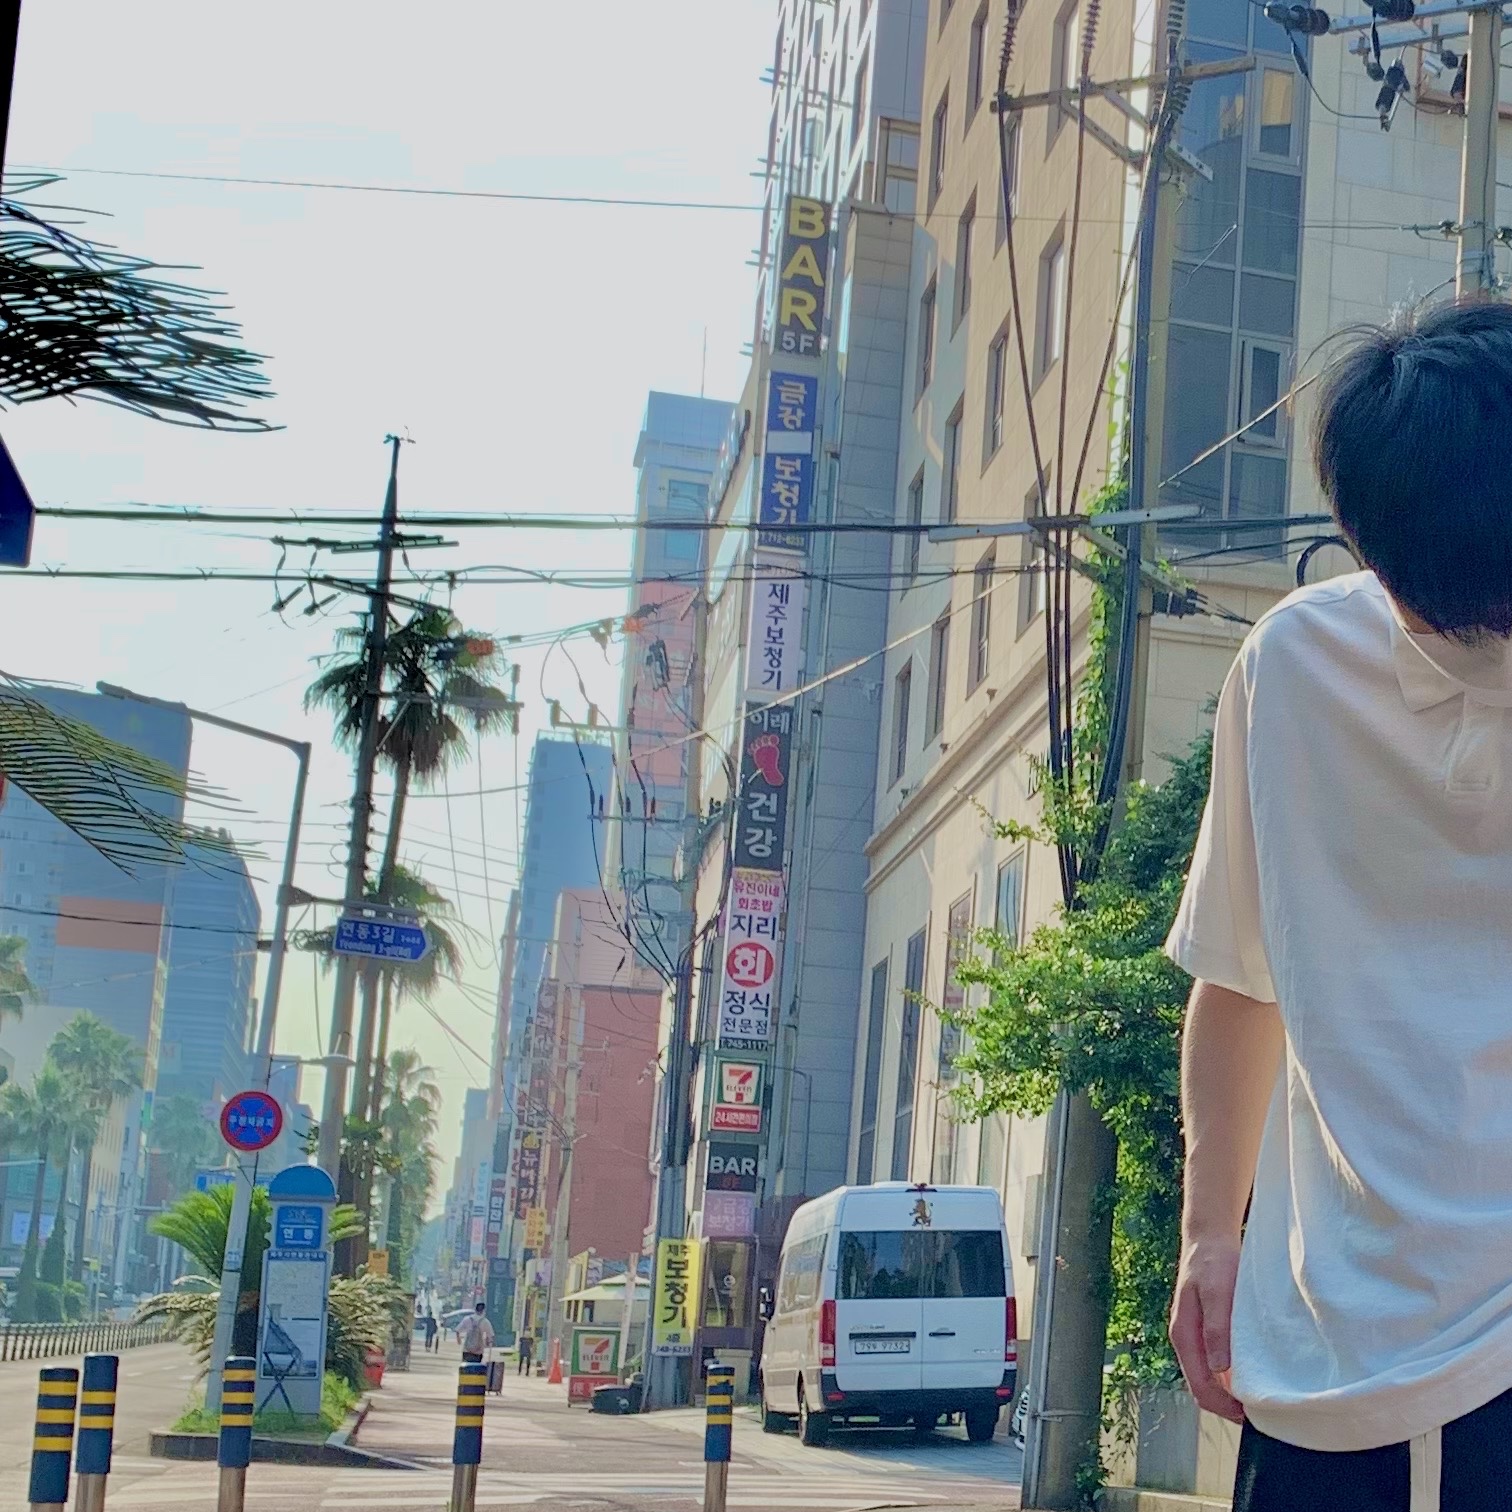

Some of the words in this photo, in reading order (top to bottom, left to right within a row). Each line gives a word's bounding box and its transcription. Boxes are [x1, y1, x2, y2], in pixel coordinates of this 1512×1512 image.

[780, 197, 826, 332] BAR
[781, 331, 815, 353] 5F
[776, 379, 808, 430] 금강
[771, 456, 802, 525] 보청기
[762, 583, 790, 691] 제주보청기
[745, 792, 778, 858] 건강
[731, 914, 777, 940] 지리
[732, 947, 767, 984] 회
[724, 990, 770, 1018] 정식
[722, 1018, 768, 1035] 전문점
[709, 1155, 757, 1176] BAR
[668, 1243, 691, 1257] 제주
[663, 1258, 690, 1328] 보청기
